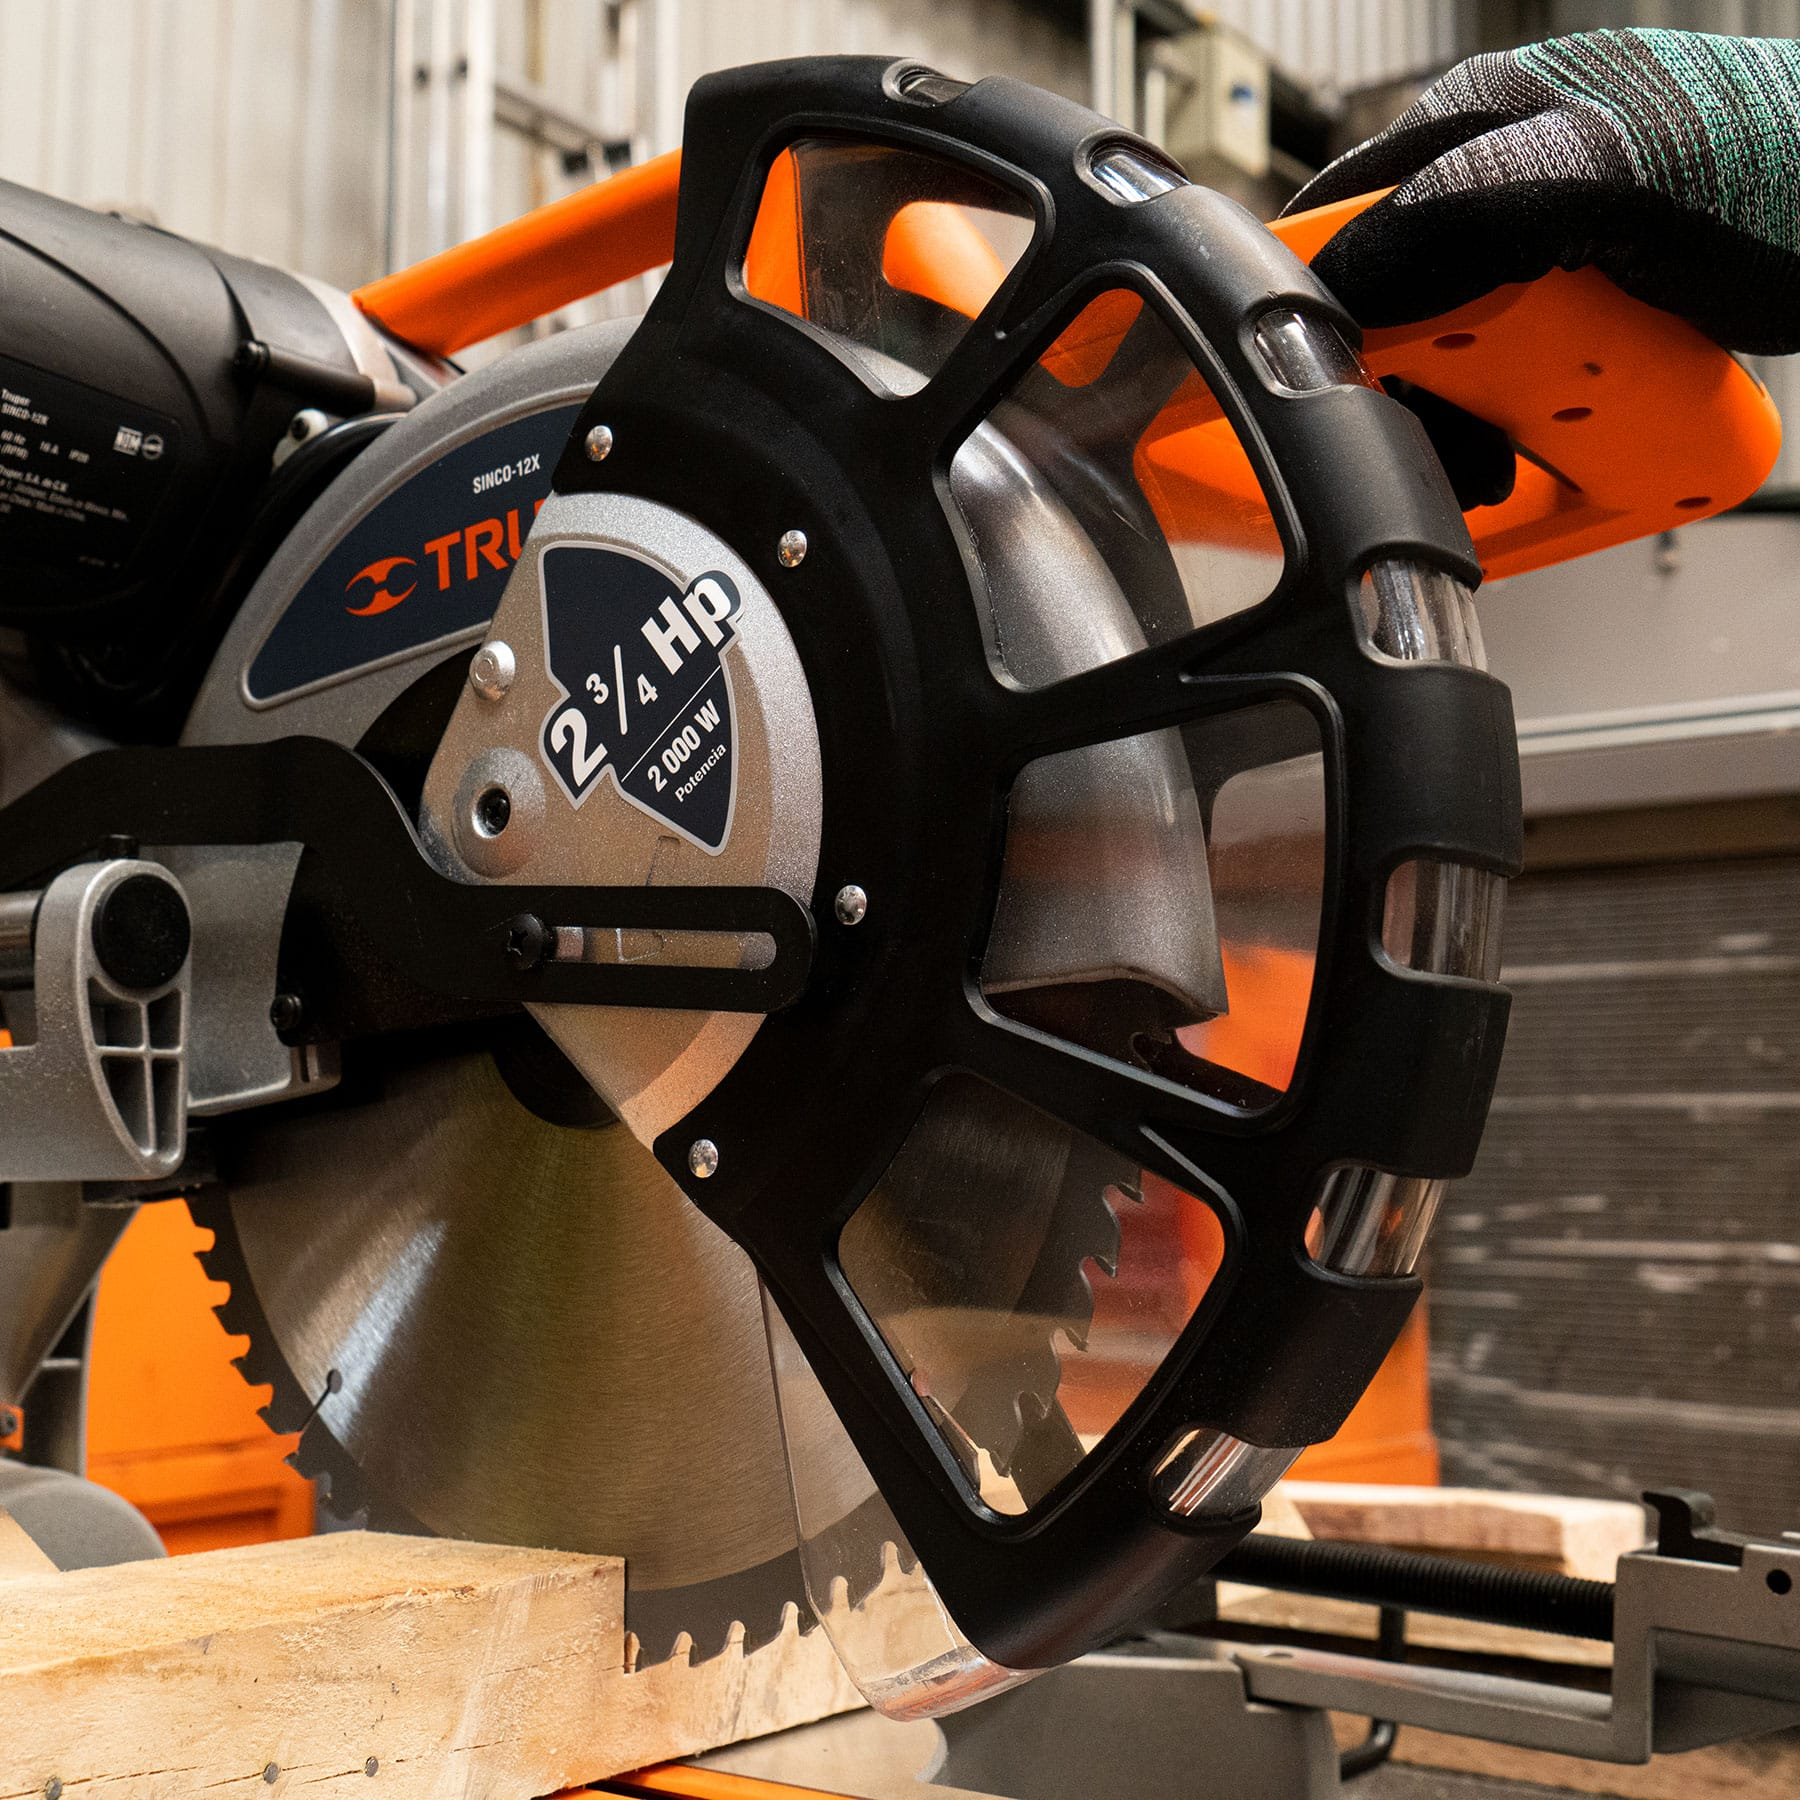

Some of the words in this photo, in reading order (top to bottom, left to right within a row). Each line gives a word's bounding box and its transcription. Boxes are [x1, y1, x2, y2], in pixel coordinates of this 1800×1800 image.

[472, 453, 541, 495] SINCO-12X
[424, 499, 546, 592] TRU
[550, 707, 609, 788] 2
[640, 578, 732, 676] Hp
[693, 698, 721, 733] W
[674, 743, 727, 803] Potencia
